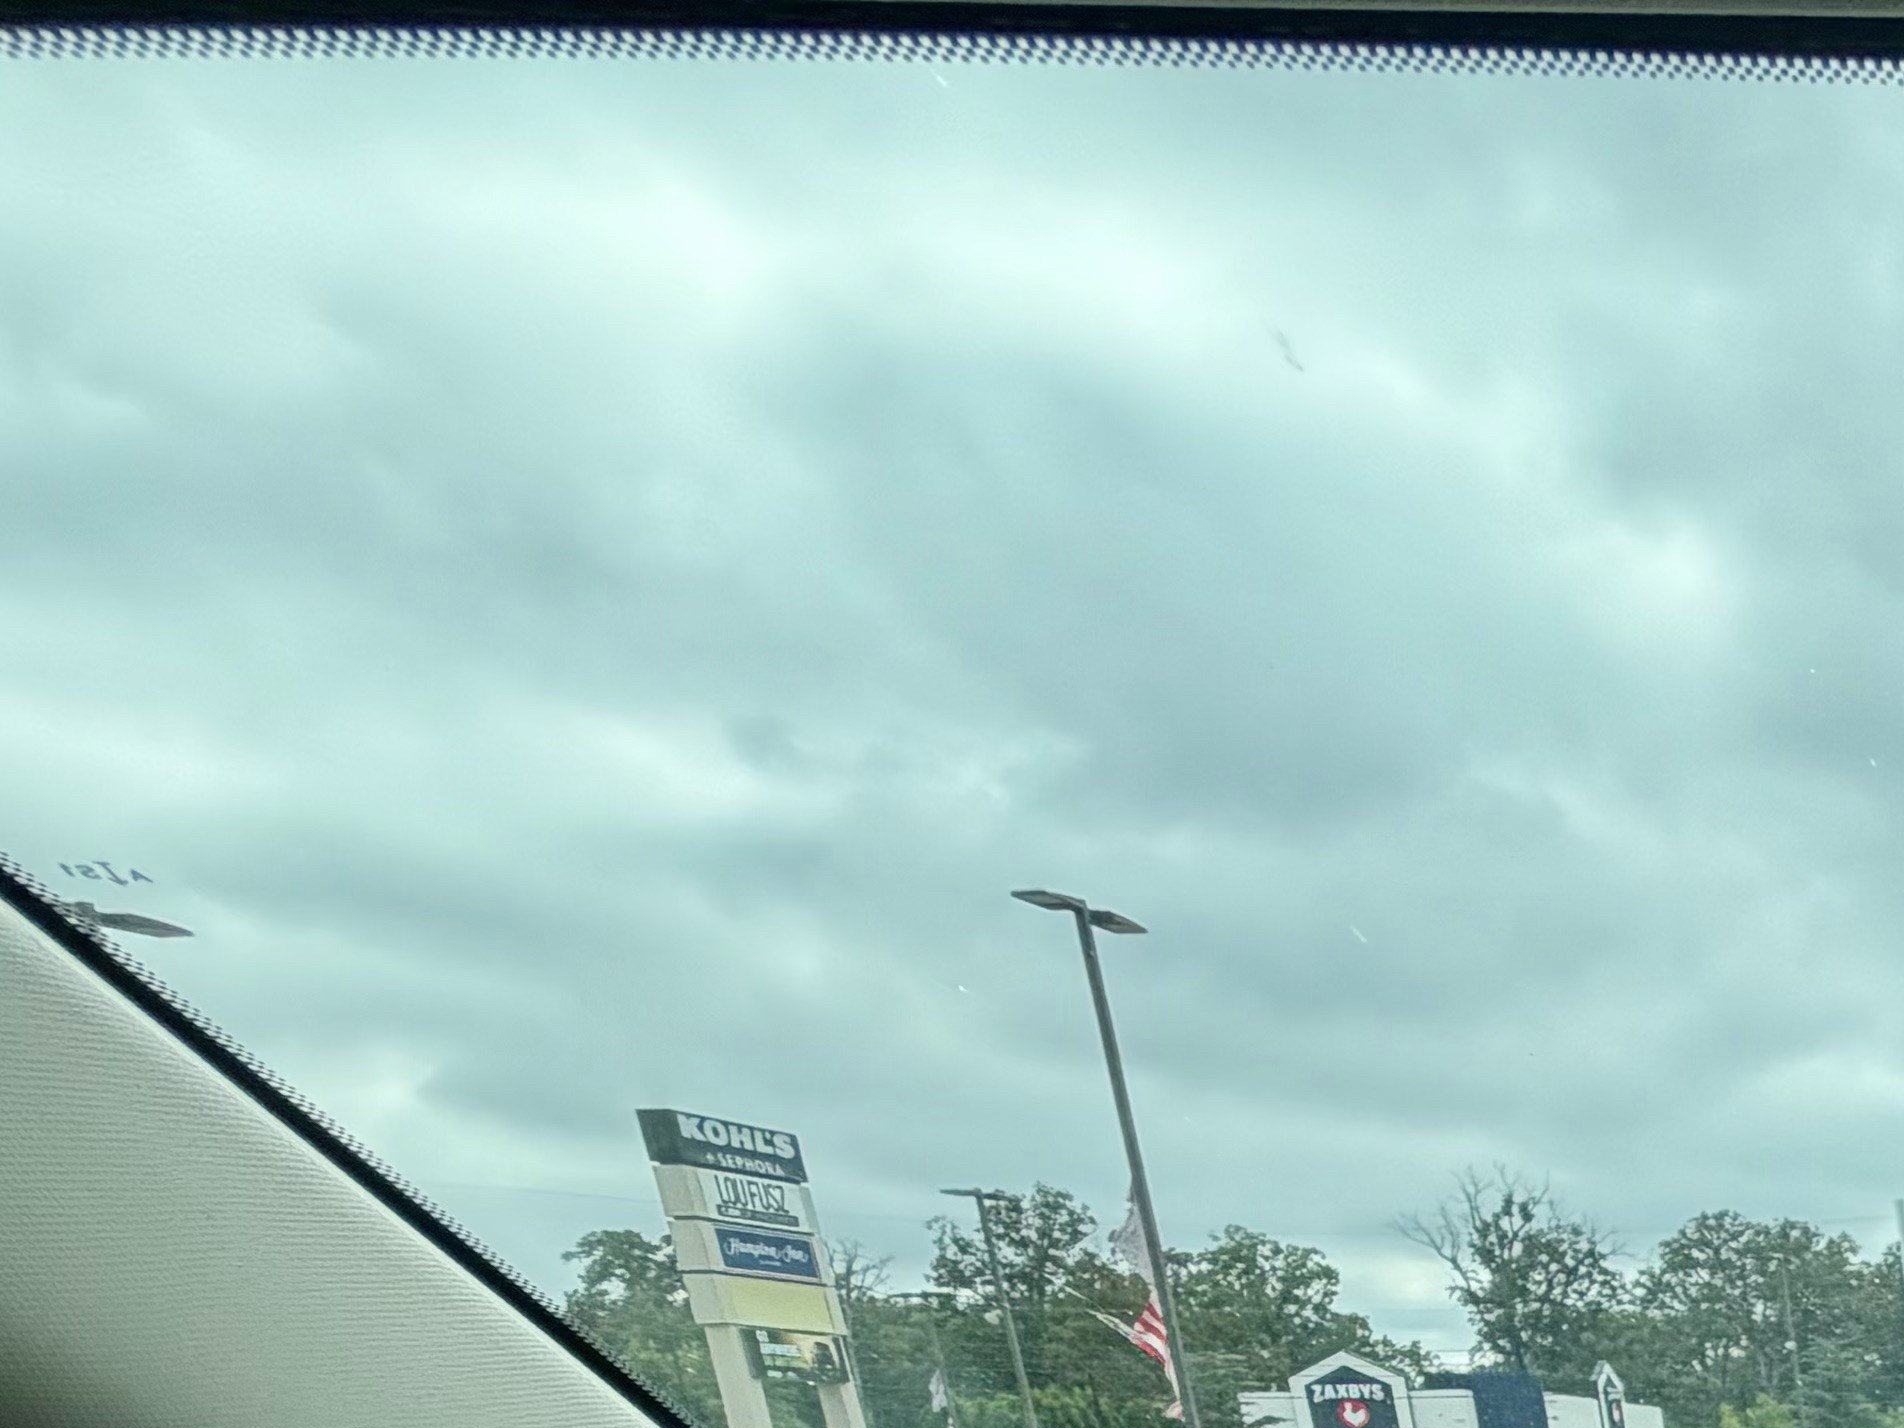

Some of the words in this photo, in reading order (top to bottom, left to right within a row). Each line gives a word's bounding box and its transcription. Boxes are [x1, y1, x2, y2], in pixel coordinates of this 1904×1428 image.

[676, 1113, 796, 1159] KOHL'S
[717, 1153, 786, 1176] SEPHORA
[1311, 1384, 1385, 1403] ZAXBYS
